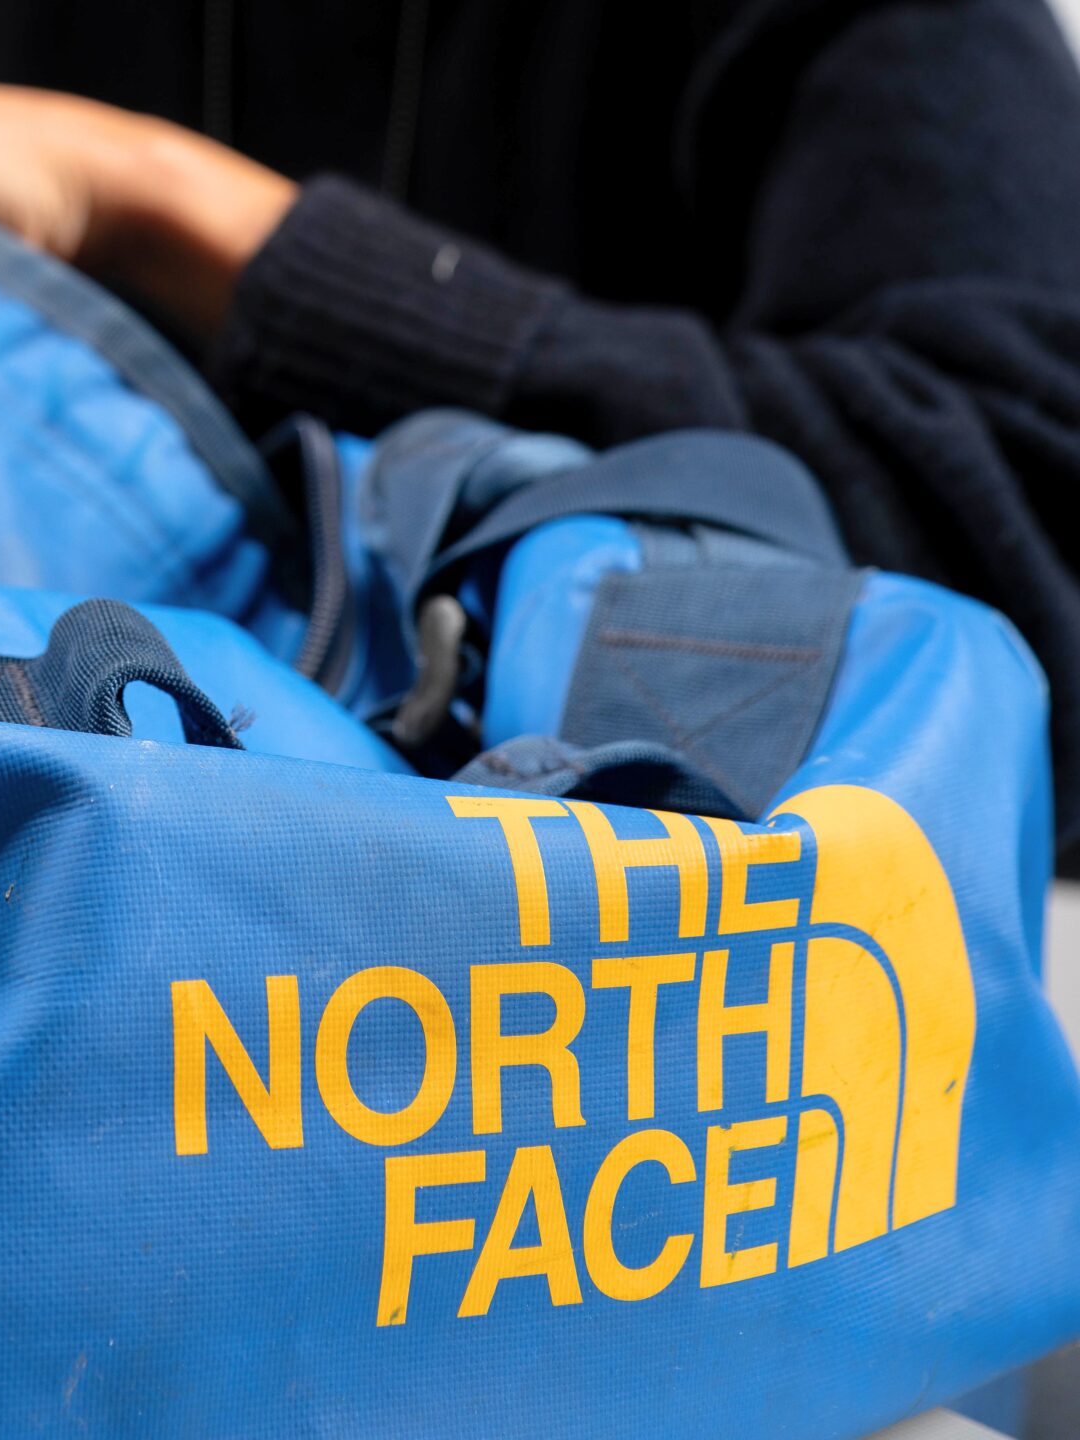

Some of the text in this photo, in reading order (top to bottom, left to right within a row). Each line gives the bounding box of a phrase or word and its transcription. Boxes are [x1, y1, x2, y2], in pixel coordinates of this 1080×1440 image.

[445, 796, 802, 946] THE
[171, 941, 795, 1155] NORTH
[376, 1116, 788, 1327] FACE
